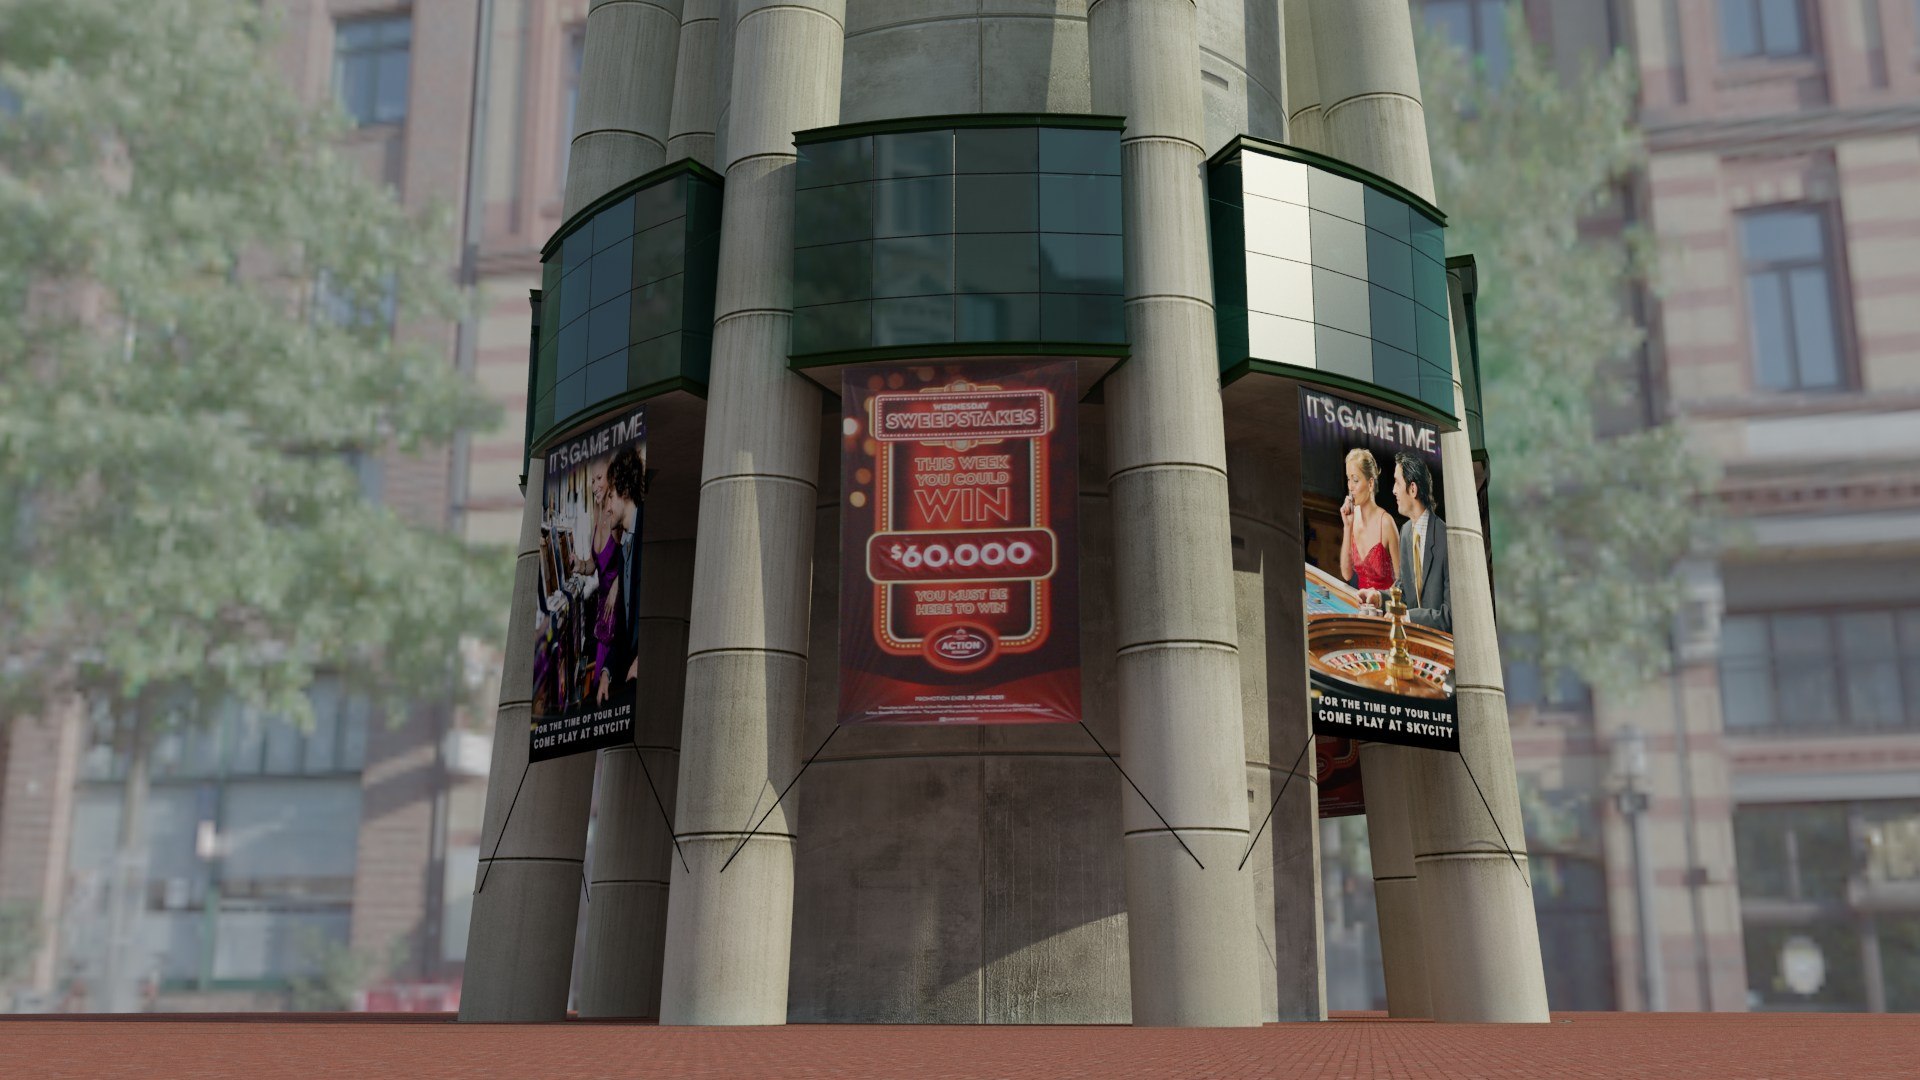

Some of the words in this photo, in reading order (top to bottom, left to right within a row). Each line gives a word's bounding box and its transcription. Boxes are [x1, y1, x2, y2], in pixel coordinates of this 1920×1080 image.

[933, 402, 989, 411] WEDNESDAY
[886, 409, 1036, 429] SWEEPSTAKES
[1306, 394, 1336, 424] IT'S
[1336, 405, 1394, 442] GAME
[1395, 421, 1436, 454] TIME
[549, 445, 569, 474] IT'S
[569, 428, 610, 465] GAME
[611, 411, 643, 447] TIME
[914, 457, 955, 472] THIS
[959, 456, 1009, 470] WEEK
[915, 473, 950, 487] YOU
[954, 471, 1009, 486] COULD
[913, 487, 1009, 524] WIN
[914, 589, 946, 602] YOU
[948, 588, 986, 601] MUST
[989, 588, 1008, 600] BE
[915, 603, 954, 616] HERE
[956, 602, 974, 615] TO
[977, 601, 1007, 614] WIN
[941, 640, 981, 651] ACTION
[535, 724, 548, 735] FOR
[549, 720, 562, 731] THE
[564, 716, 580, 728] TIME
[582, 713, 592, 724] OF
[593, 708, 613, 721] YOUR
[614, 704, 631, 717] LIFE
[1319, 695, 1339, 707] FOR
[1341, 698, 1361, 710] THE
[1363, 702, 1387, 714] TIME
[1389, 705, 1402, 716] OF
[1404, 707, 1430, 720] YOUR
[1432, 711, 1452, 723] LIFE
[533, 736, 555, 750] COME
[558, 729, 578, 744] PLAY
[580, 727, 591, 740] AT
[593, 718, 631, 737] SKYCITY
[1318, 710, 1352, 725] COME
[1356, 715, 1384, 729] PLAY
[1388, 719, 1402, 732] AT
[1406, 722, 1453, 738] SKYCITY
